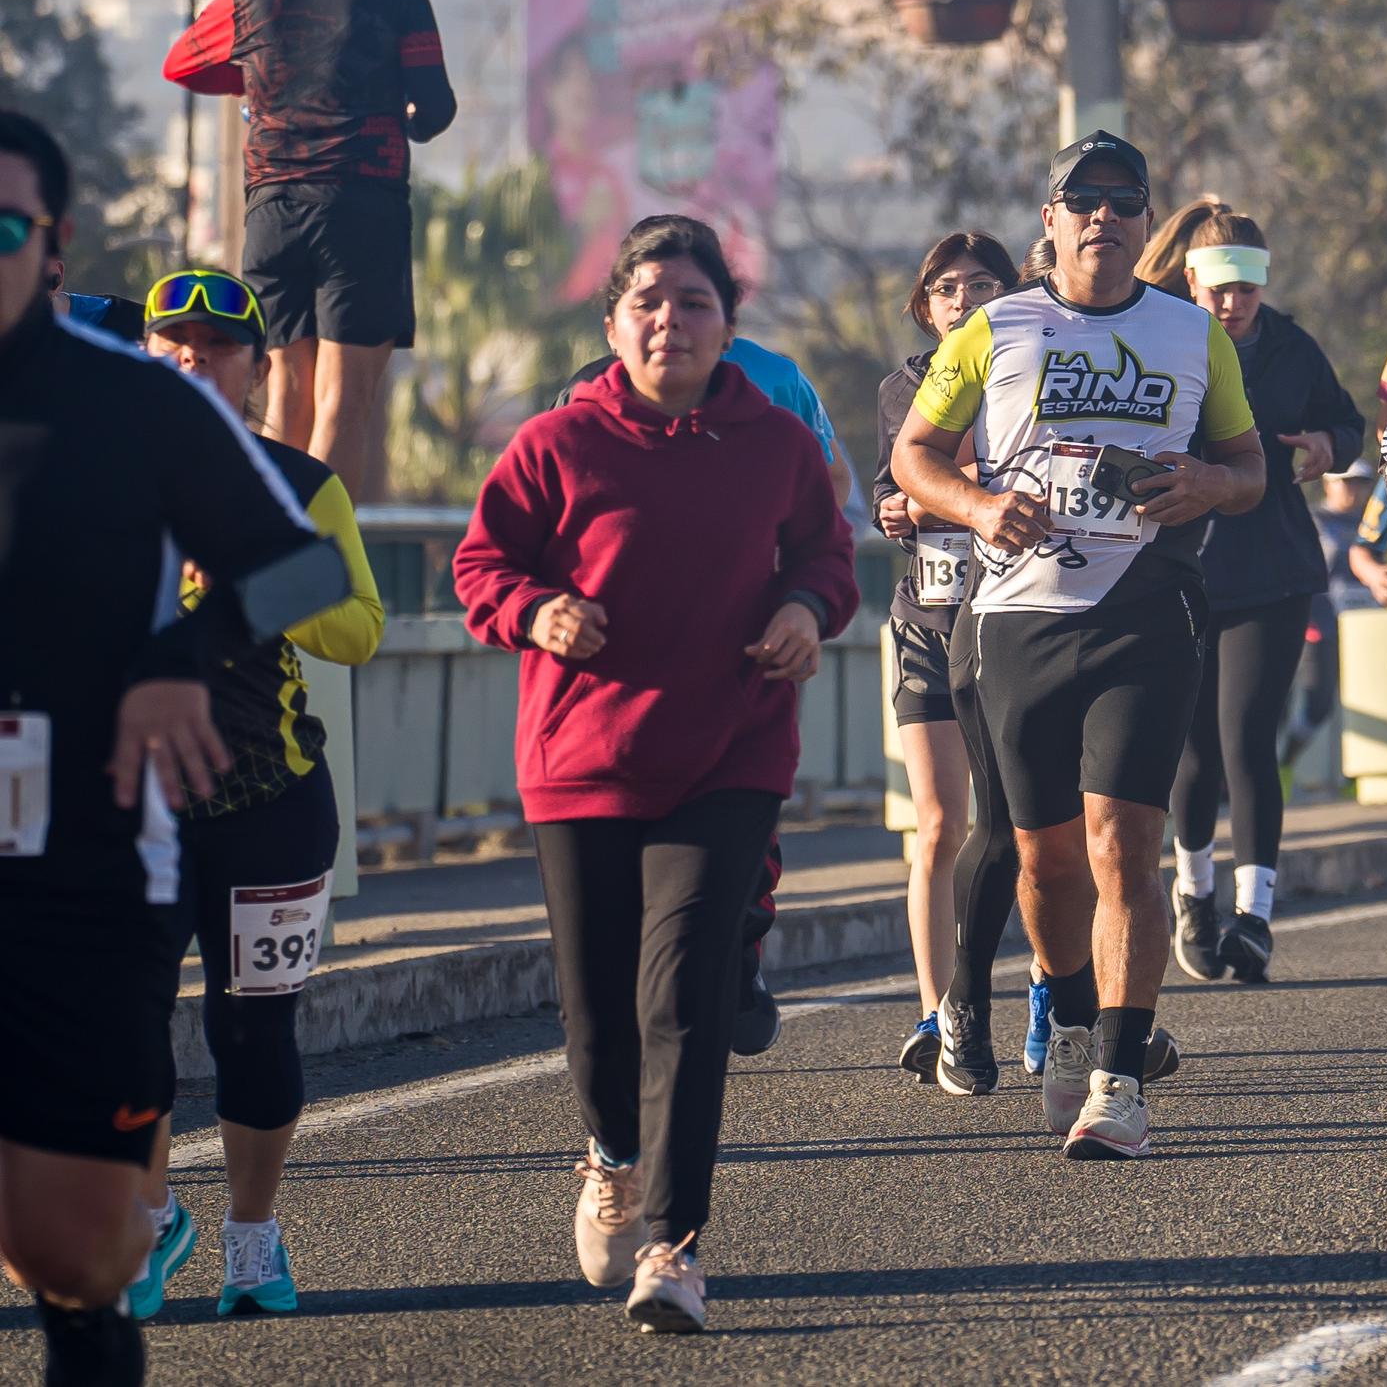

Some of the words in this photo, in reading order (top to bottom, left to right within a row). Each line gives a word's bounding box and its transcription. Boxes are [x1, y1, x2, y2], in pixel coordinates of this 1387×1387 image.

[1048, 354, 1088, 371] LA
[1039, 353, 1172, 404] RINO
[1041, 400, 1163, 418] ESTAMPIDA
